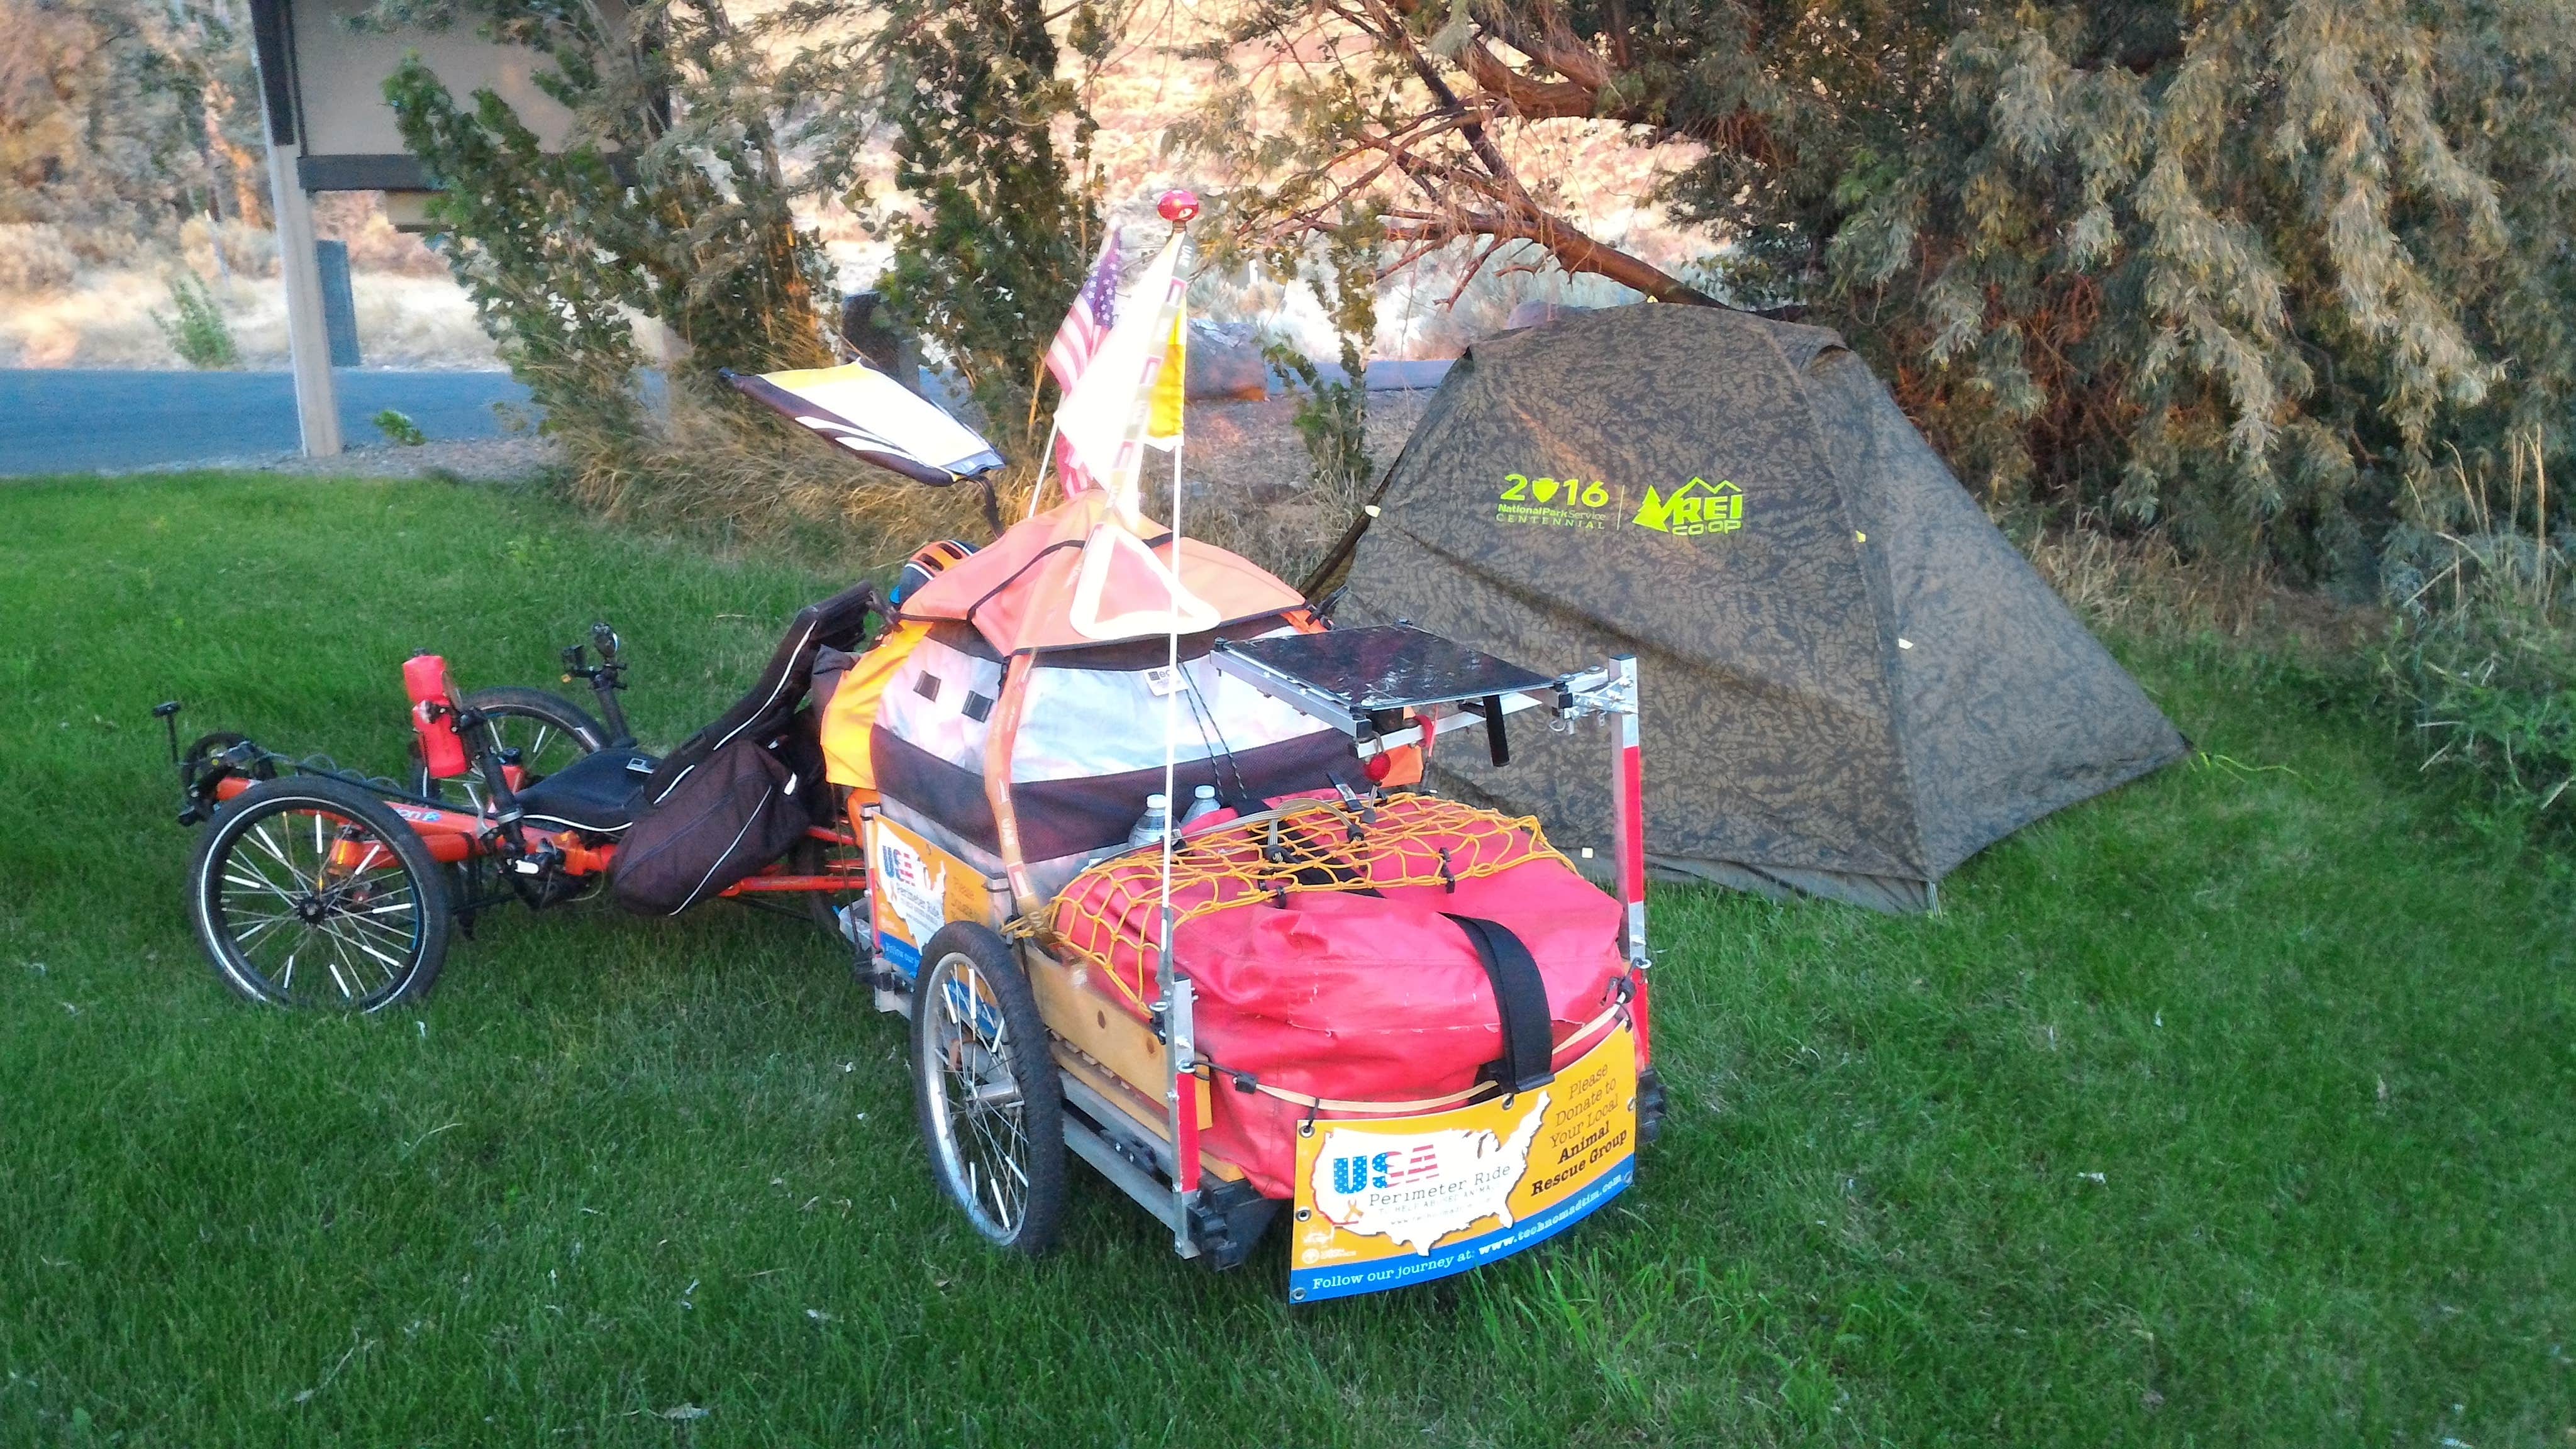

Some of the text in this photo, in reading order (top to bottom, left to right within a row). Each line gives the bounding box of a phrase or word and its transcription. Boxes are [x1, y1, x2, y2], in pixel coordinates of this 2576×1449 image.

[1496, 513, 1605, 530] CENTENNIAL
[1672, 494, 1743, 525] REI
[882, 845, 916, 887] USA
[1555, 1078, 1616, 1128] Donate to
[1569, 1063, 1607, 1100] Please
[1550, 1093, 1618, 1148] Your Local
[1531, 1130, 1628, 1196] Rescue Group
[1557, 1121, 1609, 1164] Animal
[1333, 1144, 1440, 1194] USA
[1369, 1165, 1511, 1206] Perimeter Ride
[1313, 1272, 1363, 1289] Follow
[1367, 1269, 1395, 1281] our
[1396, 1256, 1454, 1279] journey
[1457, 1249, 1475, 1262] at:
[1479, 1174, 1621, 1255] www.technomadtim.com
